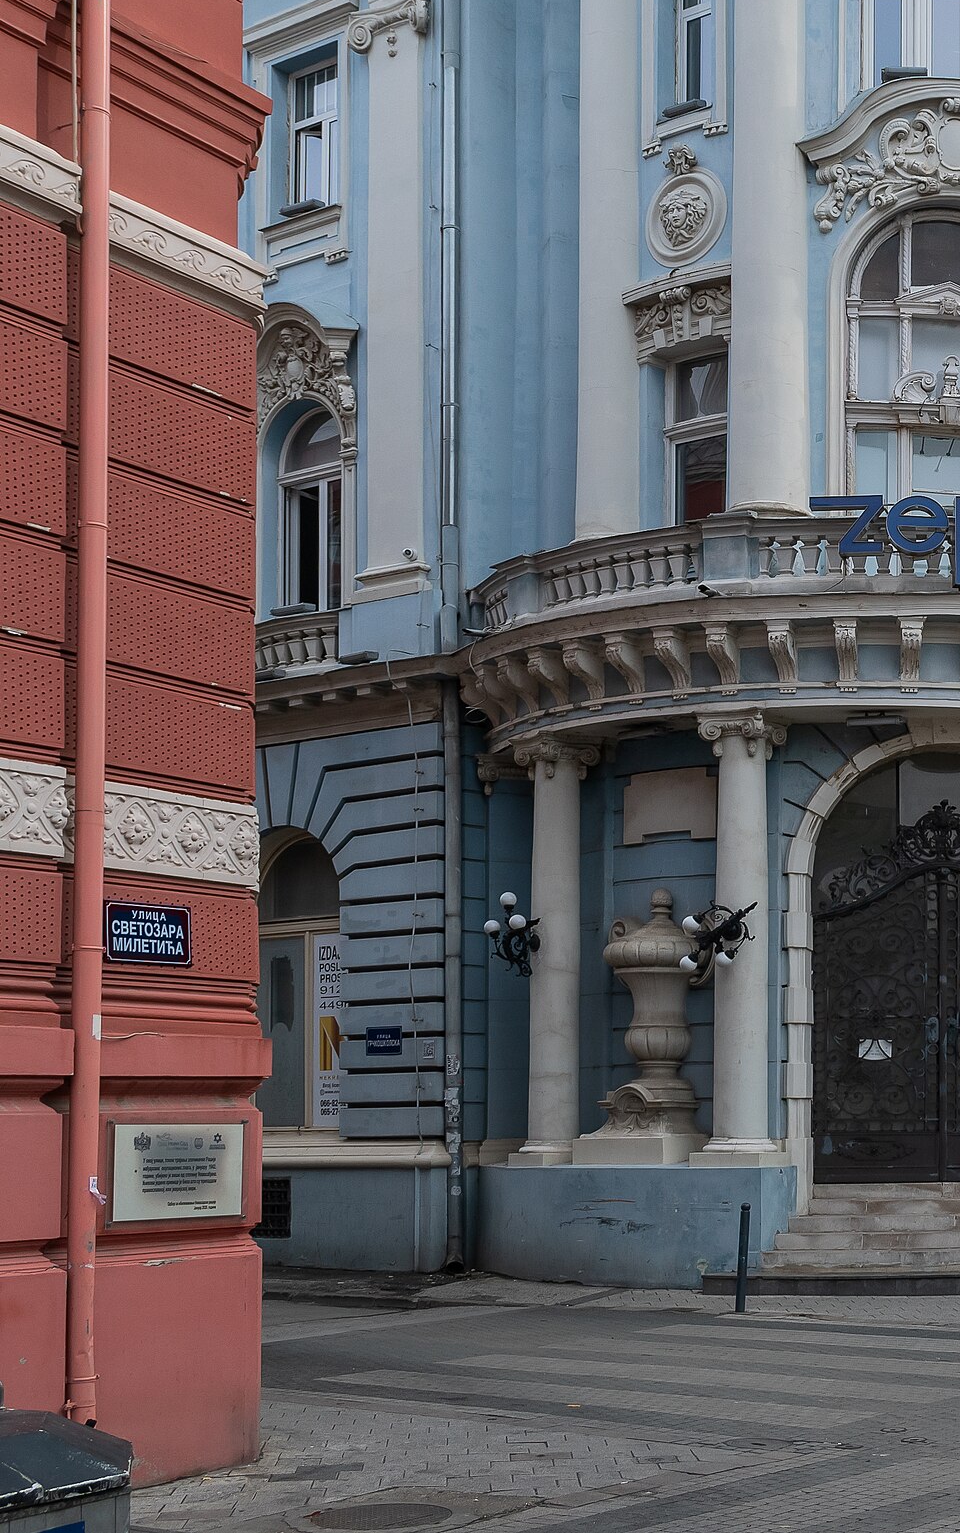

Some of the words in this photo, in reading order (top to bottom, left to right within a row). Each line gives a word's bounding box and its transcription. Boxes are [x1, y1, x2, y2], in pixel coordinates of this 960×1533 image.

[131, 910, 167, 922] УЛИЦА
[111, 919, 184, 939] СВЕТОЗАРА
[112, 937, 184, 956] МИЛЕТИЋА
[319, 962, 344, 972] POSL
